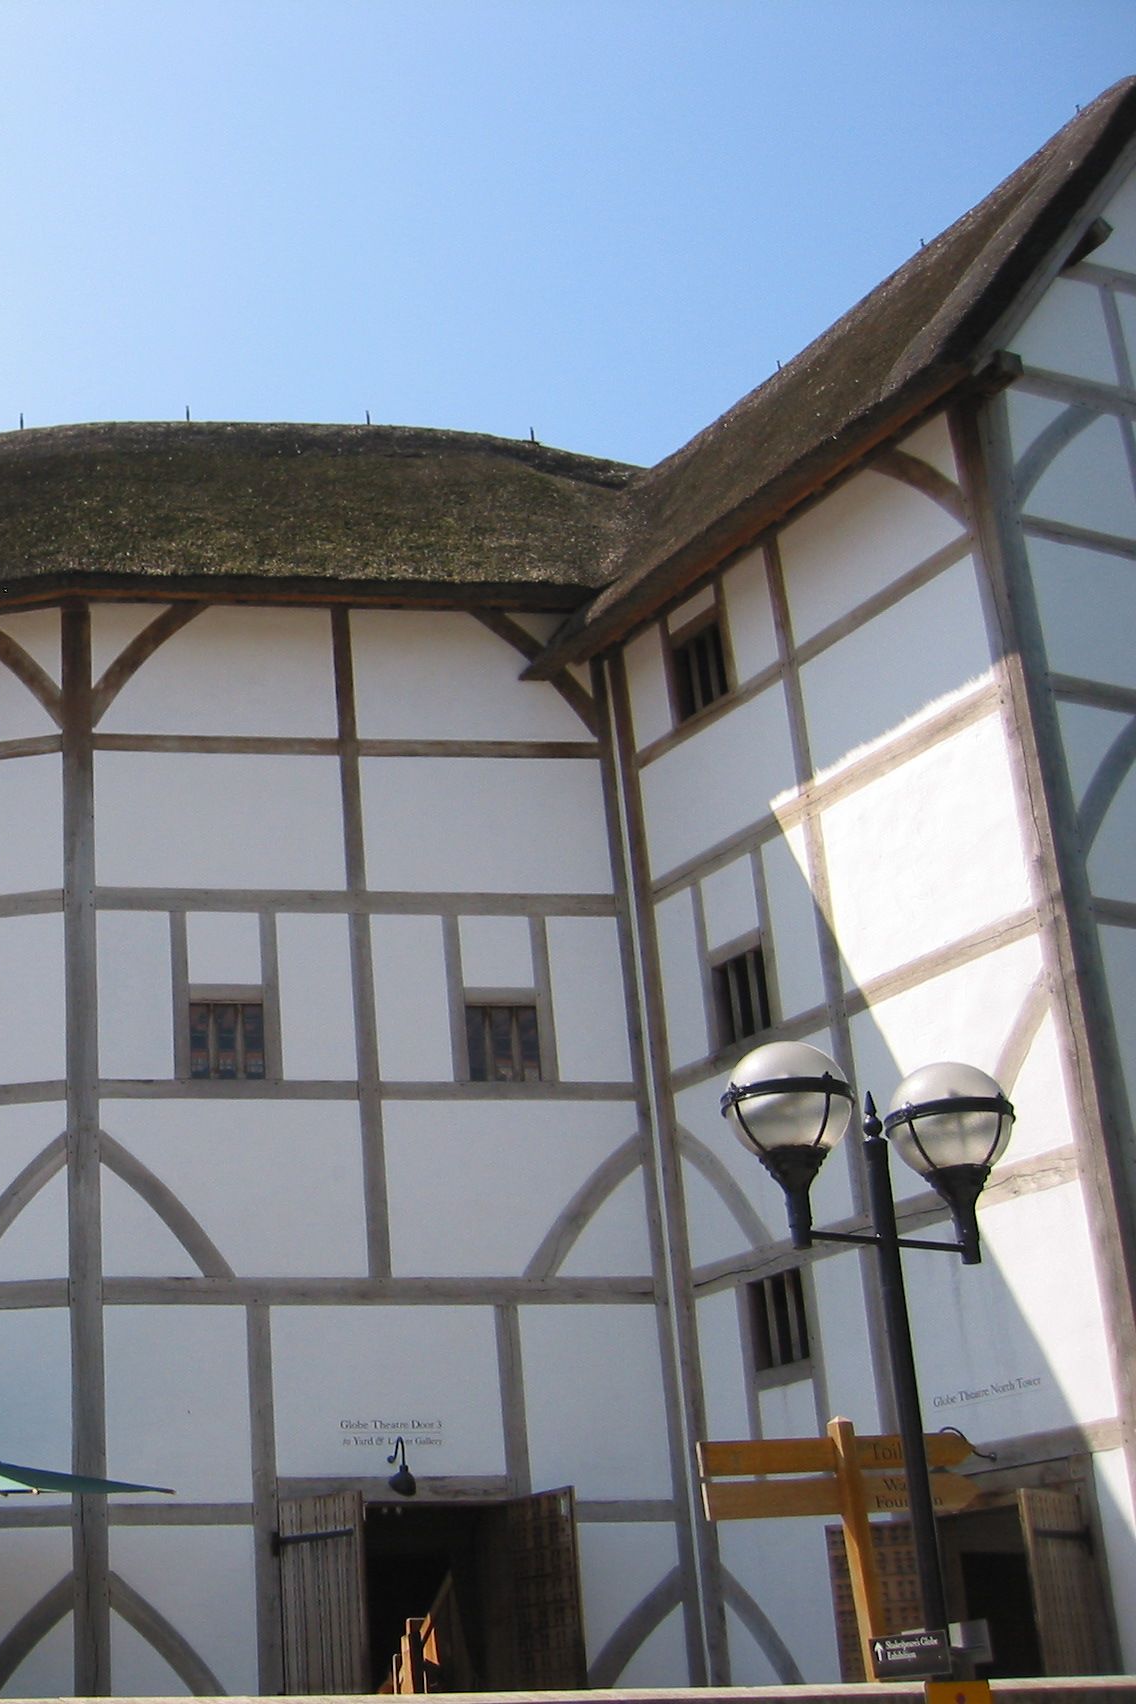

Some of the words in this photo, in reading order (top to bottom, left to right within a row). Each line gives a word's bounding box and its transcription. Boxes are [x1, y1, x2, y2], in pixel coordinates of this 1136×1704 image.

[933, 1395, 957, 1408] Globe
[958, 1389, 989, 1402] Theatre
[990, 1381, 1015, 1394] North
[1016, 1377, 1041, 1389] Tower
[340, 1420, 369, 1430] Globe
[373, 1420, 409, 1430] Theatre
[411, 1420, 435, 1430] Door
[352, 1436, 373, 1447] Yard
[414, 1437, 442, 1446] Gallery
